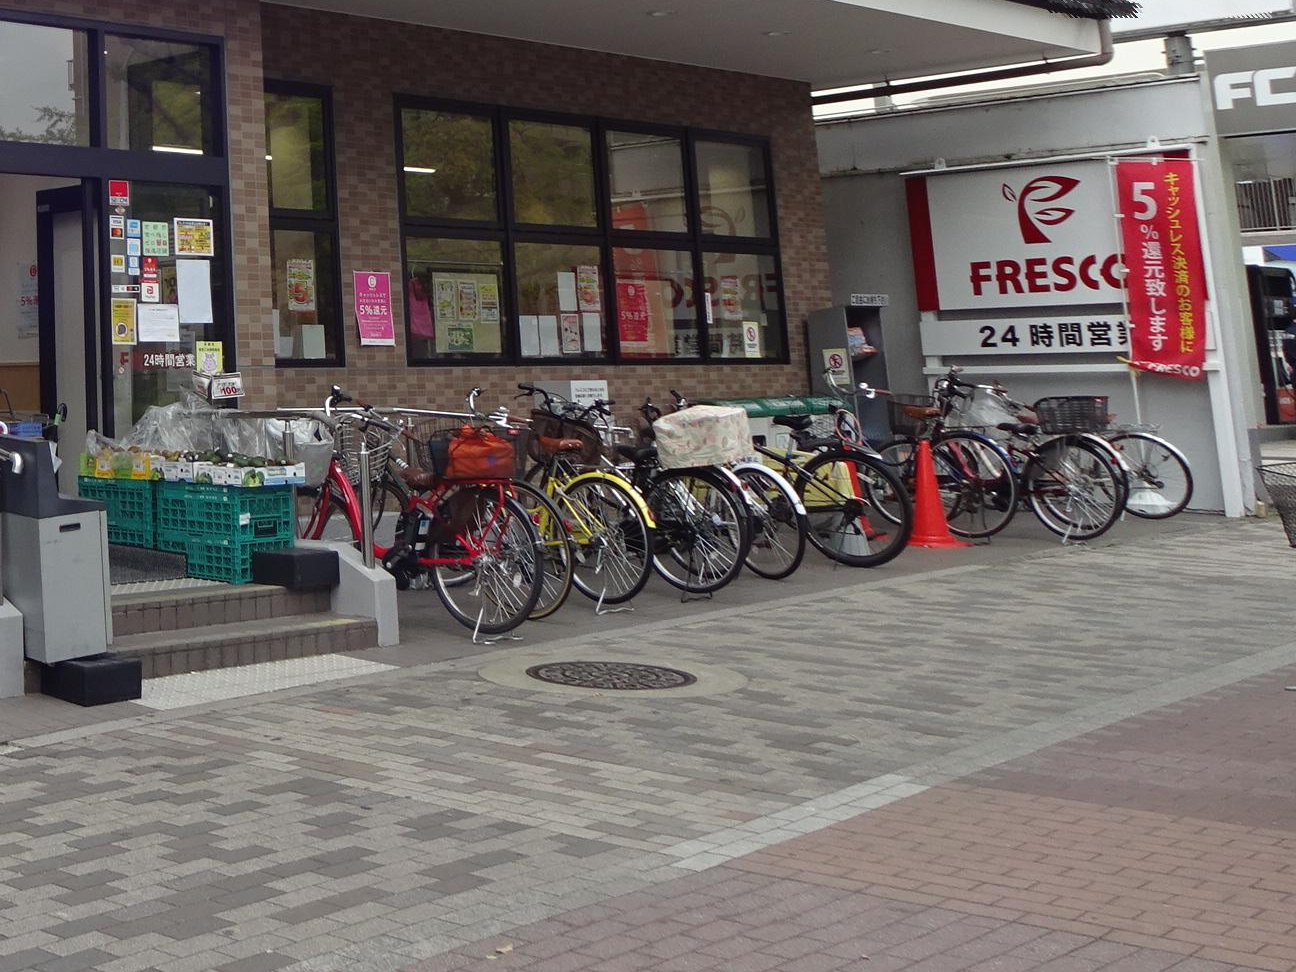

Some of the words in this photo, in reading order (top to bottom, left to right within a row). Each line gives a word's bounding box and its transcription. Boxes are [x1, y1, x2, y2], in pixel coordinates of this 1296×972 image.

[970, 254, 1128, 296] FRESCO
[143, 353, 196, 367] 24時間営業
